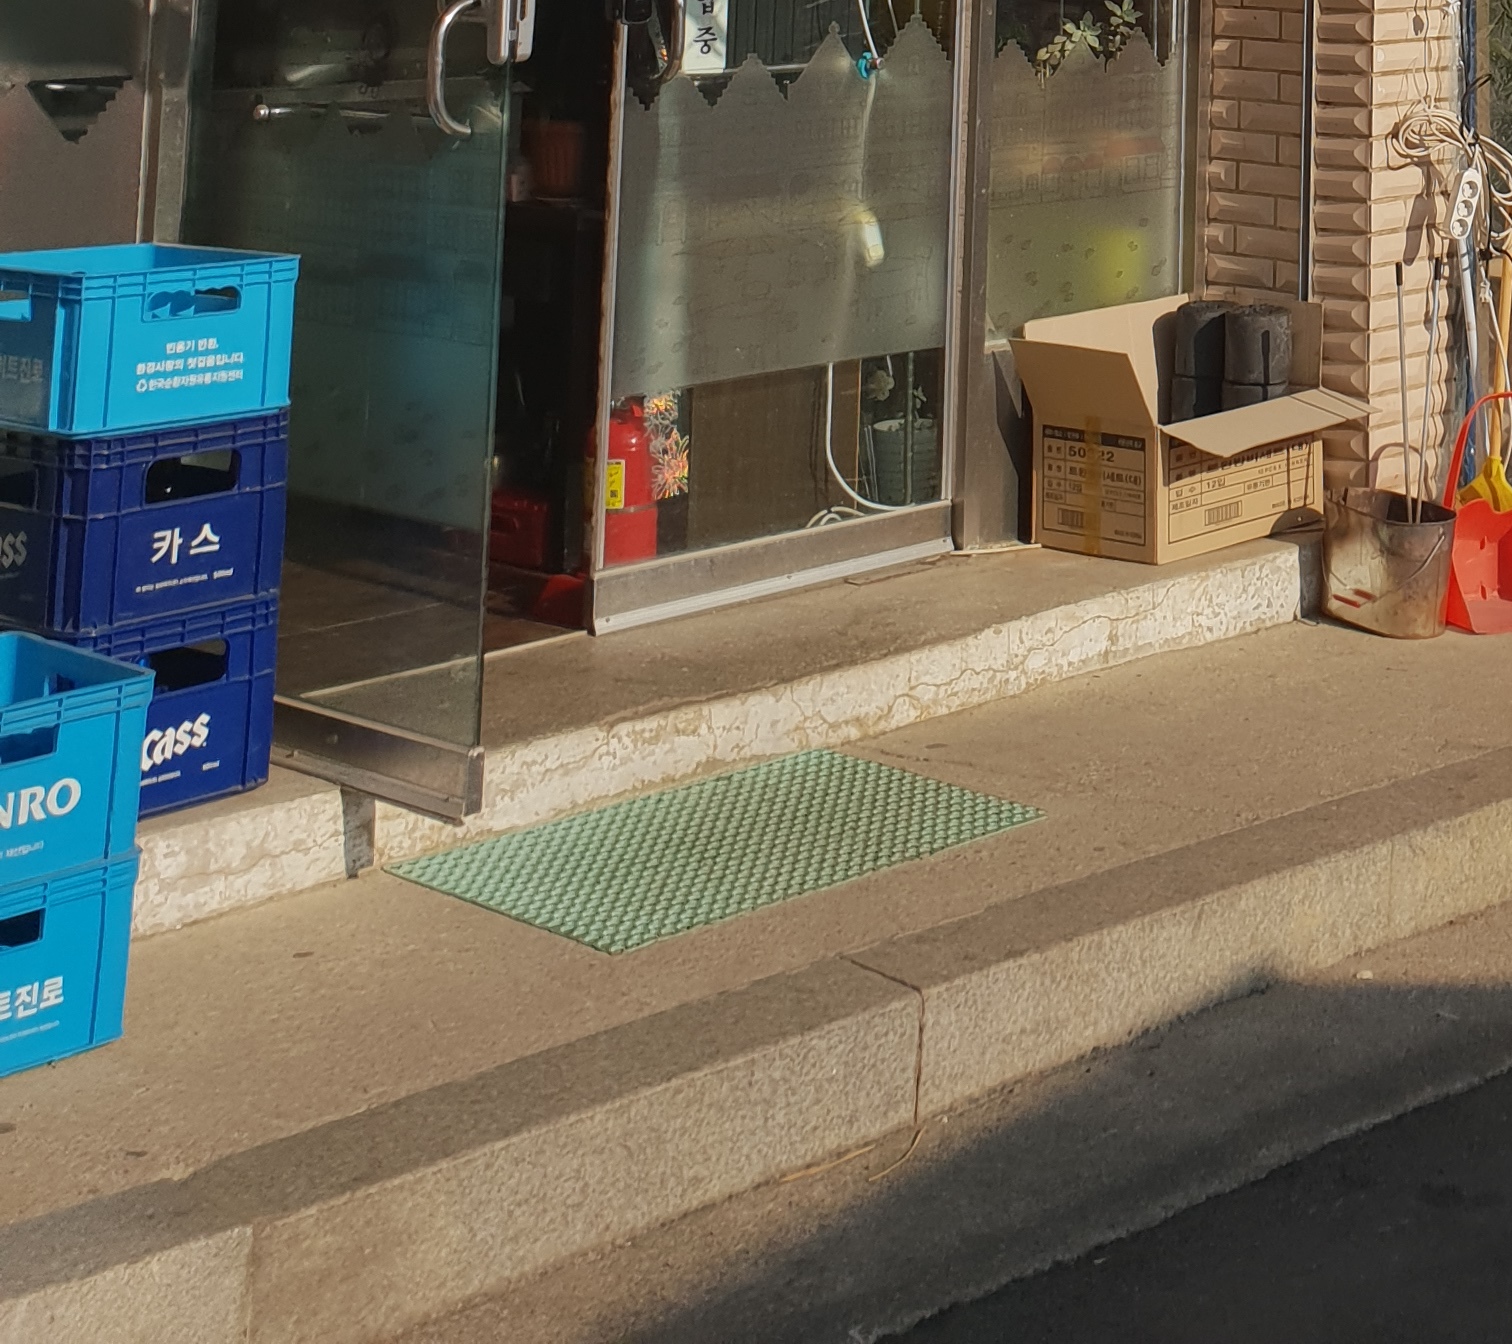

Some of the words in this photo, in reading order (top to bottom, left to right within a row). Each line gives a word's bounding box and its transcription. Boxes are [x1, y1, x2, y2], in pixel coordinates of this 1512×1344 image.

[1206, 476, 1226, 489] 12입
[151, 523, 221, 564] 카스
[141, 712, 211, 772] Cass
